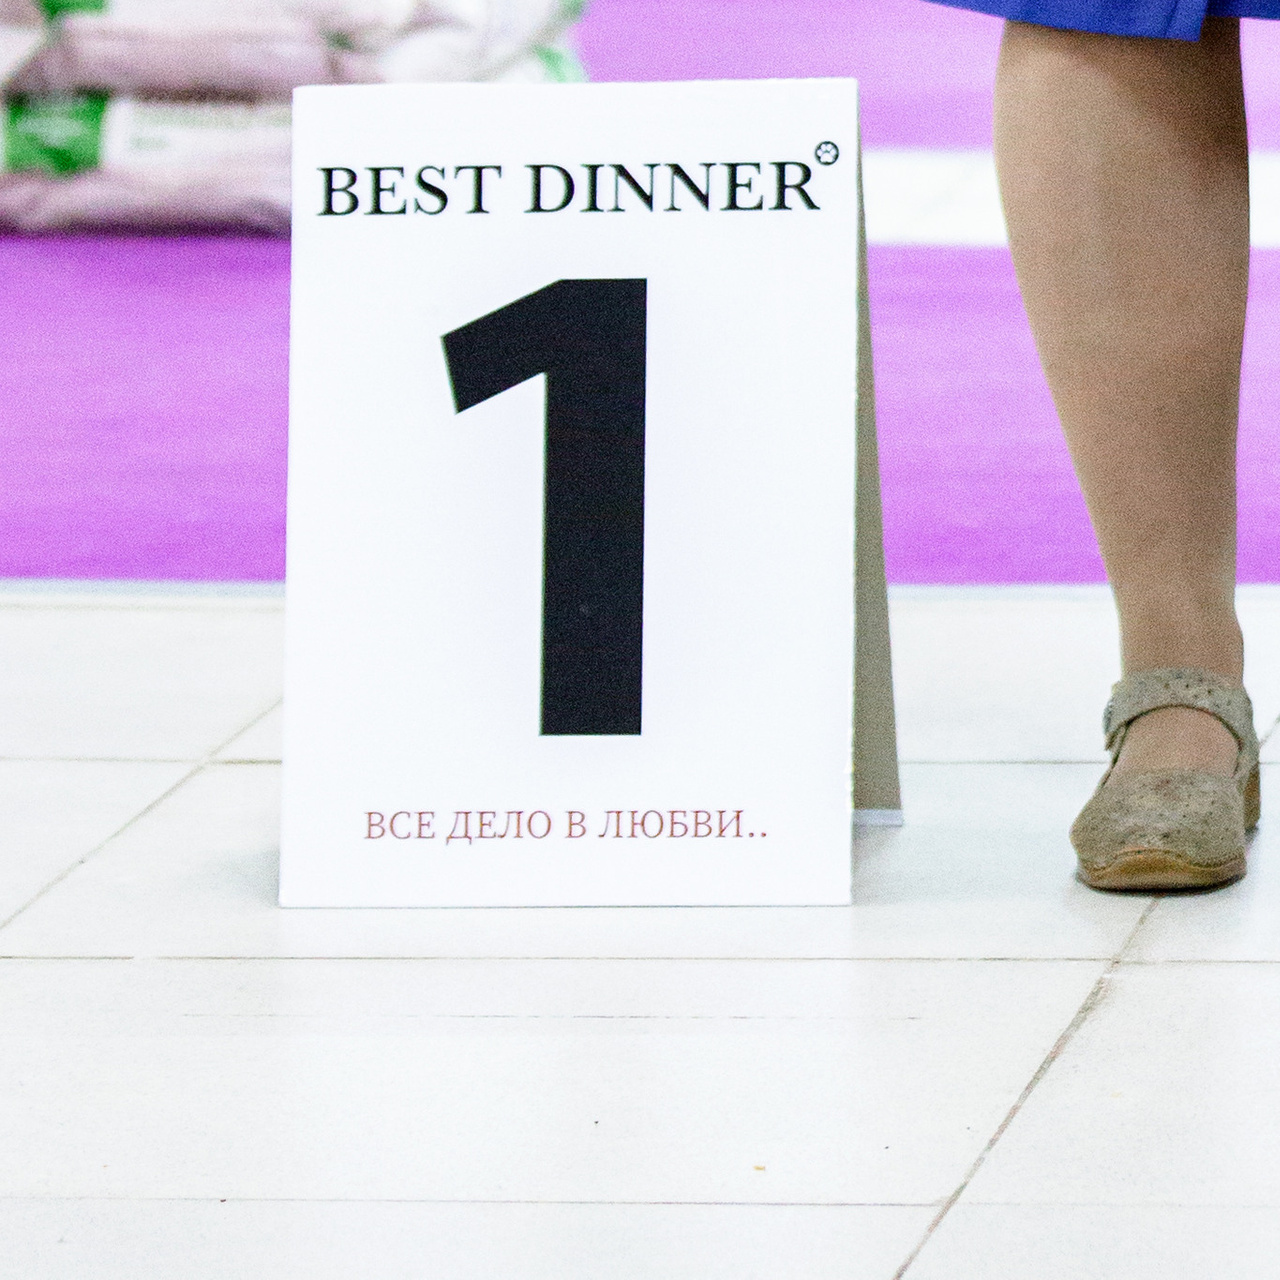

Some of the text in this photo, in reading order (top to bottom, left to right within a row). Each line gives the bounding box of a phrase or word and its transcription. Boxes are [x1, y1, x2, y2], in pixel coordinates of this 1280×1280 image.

[316, 160, 822, 217] BEST DINNER
[440, 277, 649, 737] 1
[363, 809, 769, 846] ВСЕ ДЕЛО В ЛЮБВИ..
